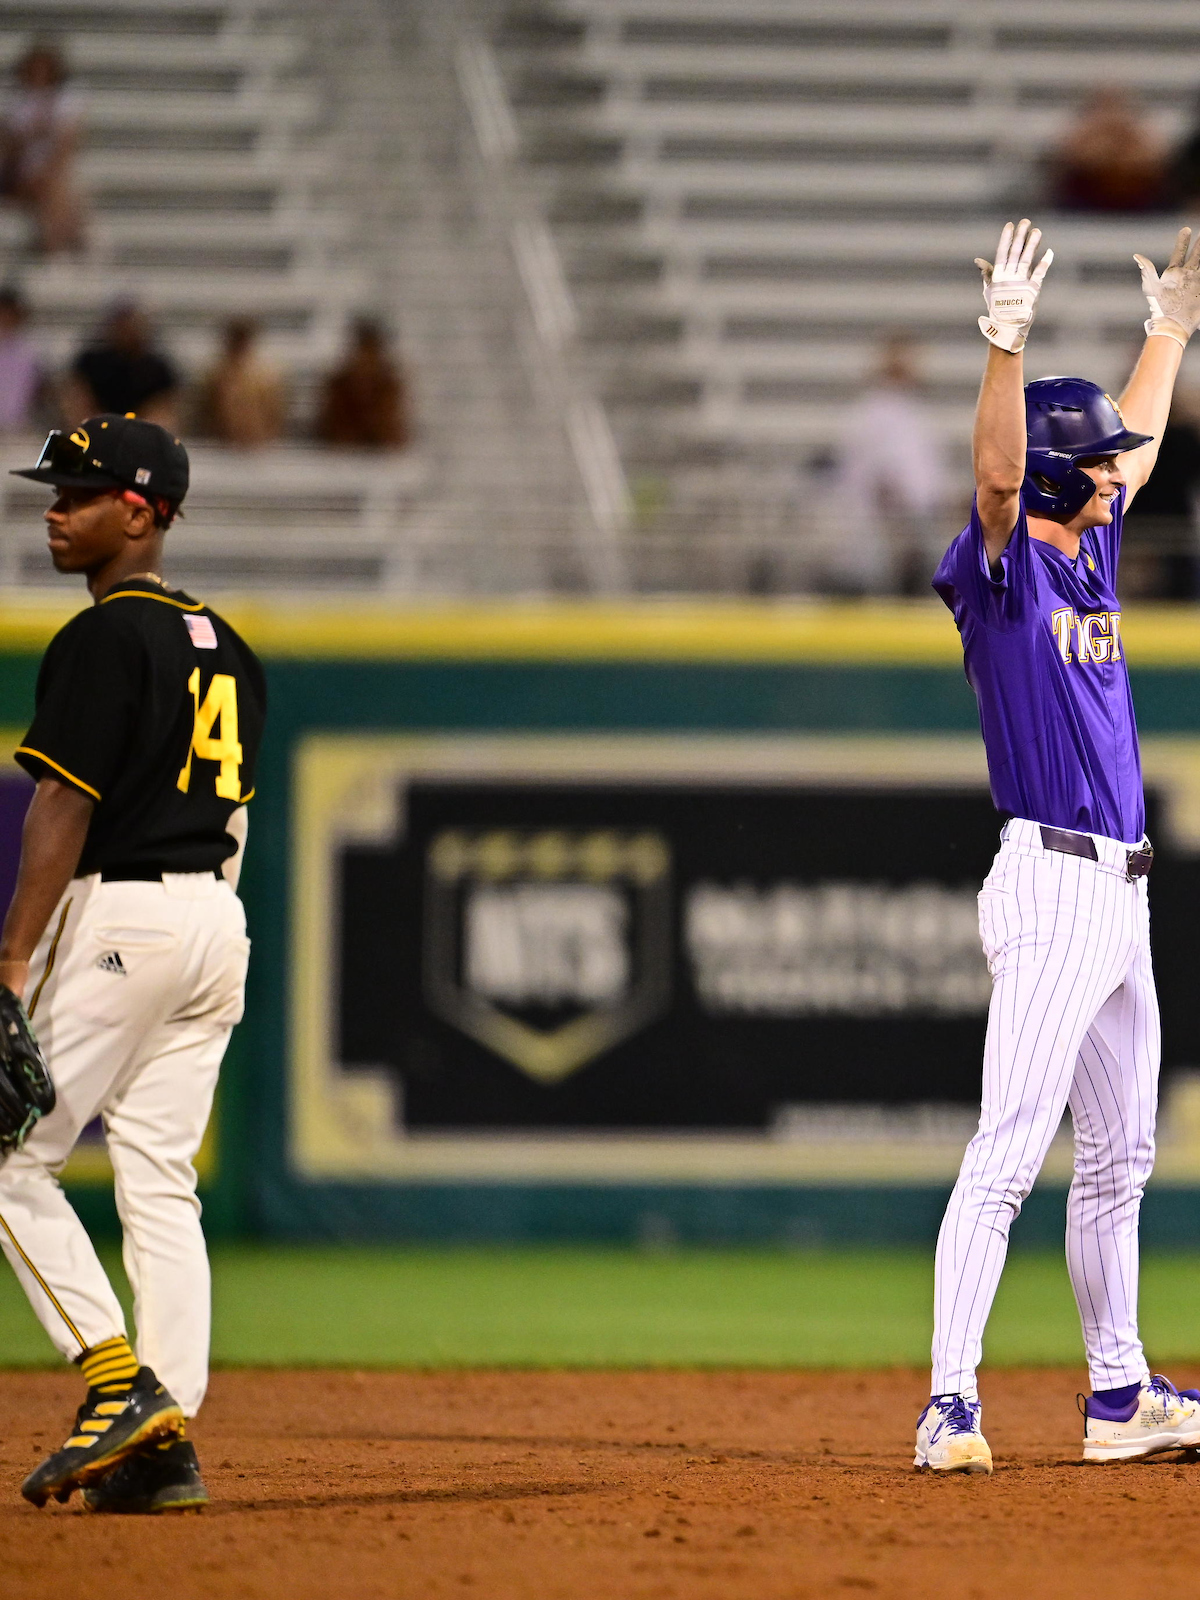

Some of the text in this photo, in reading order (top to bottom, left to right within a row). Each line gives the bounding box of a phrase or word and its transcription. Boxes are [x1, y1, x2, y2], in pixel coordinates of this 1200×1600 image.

[994, 297, 1024, 306] marucci
[1048, 450, 1073, 459] marucci
[176, 667, 243, 802] 14
